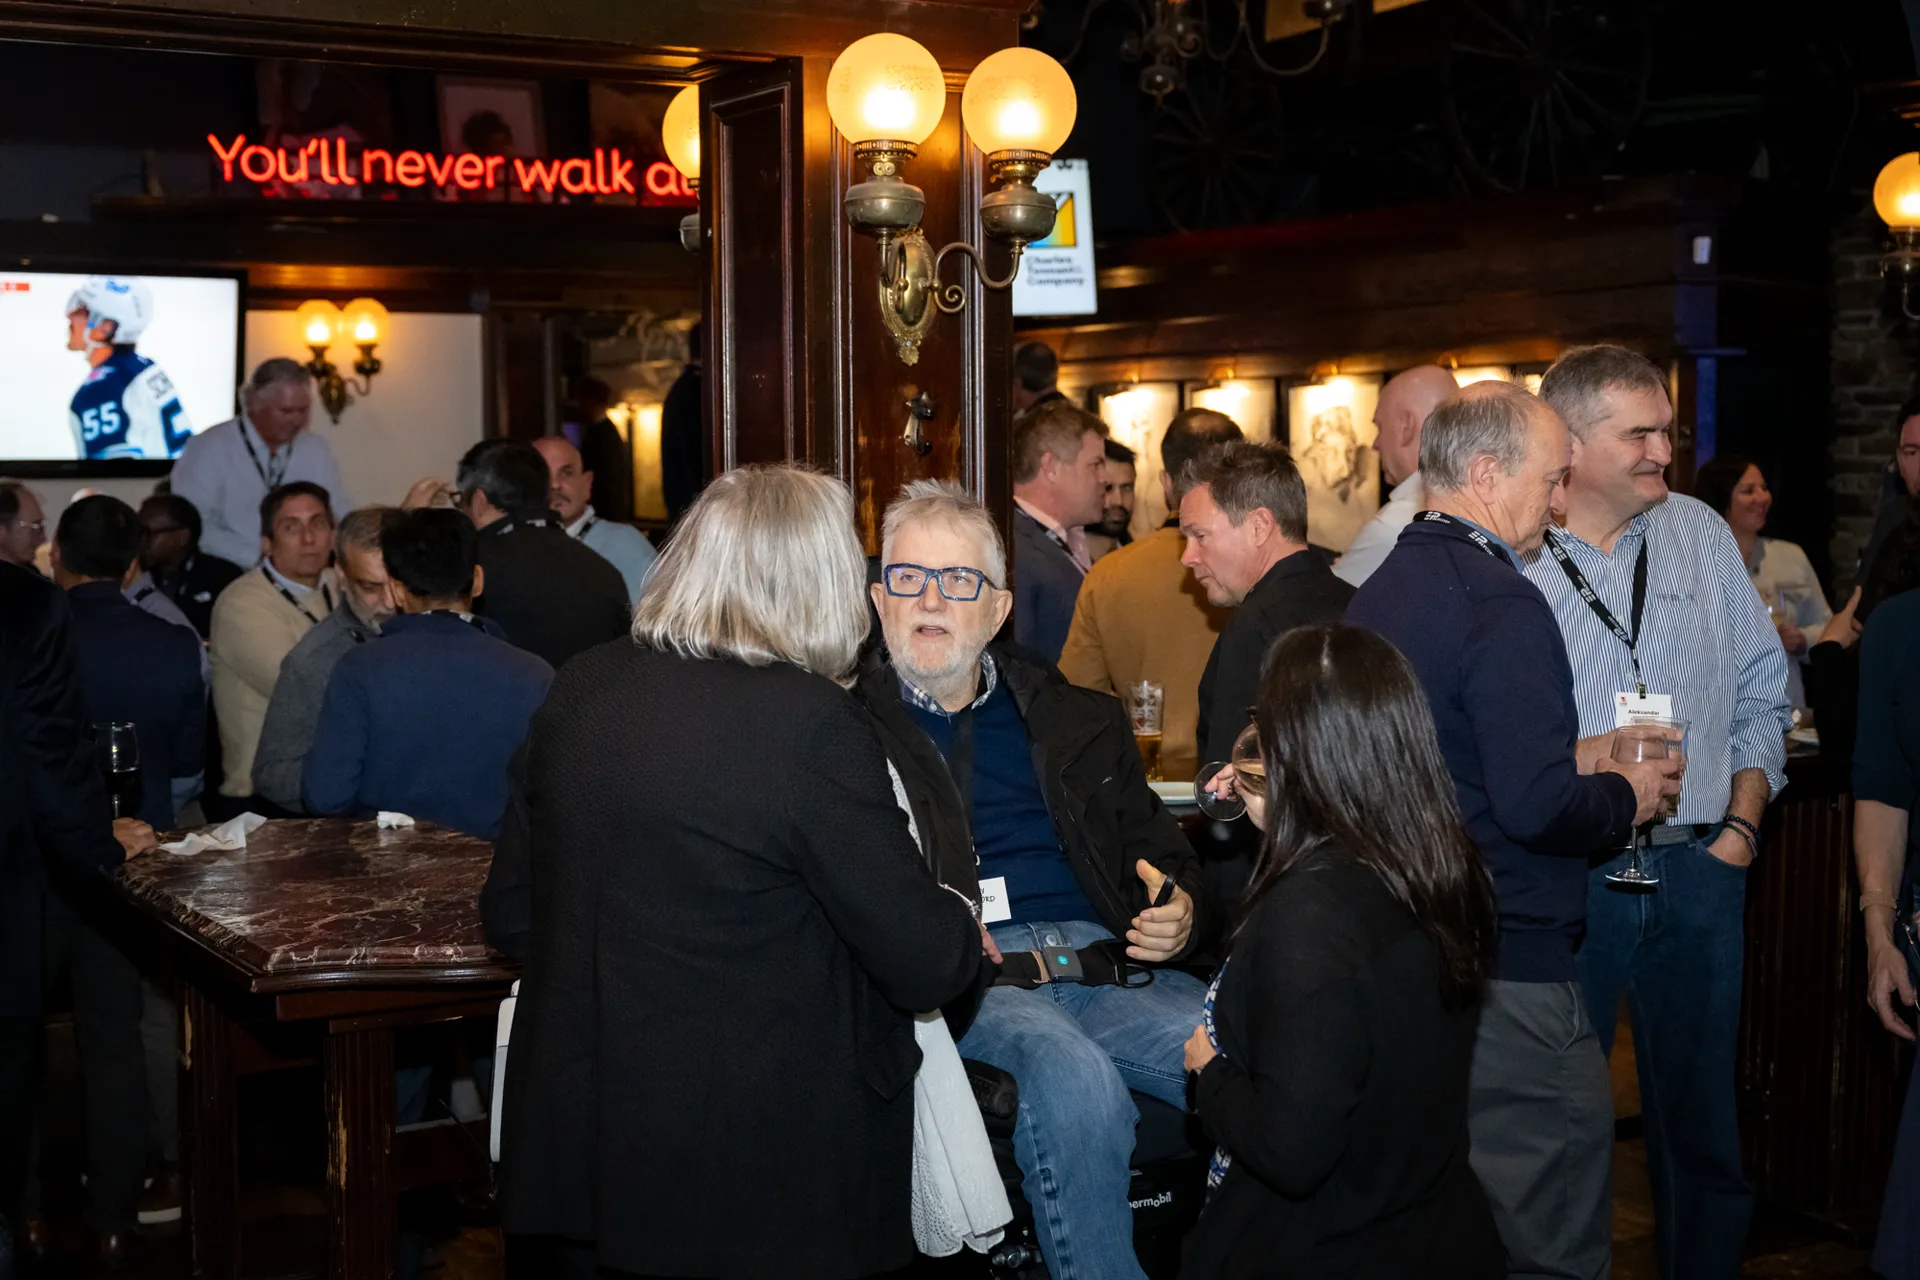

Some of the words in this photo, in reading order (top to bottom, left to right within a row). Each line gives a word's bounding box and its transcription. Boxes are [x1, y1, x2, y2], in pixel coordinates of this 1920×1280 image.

[207, 133, 358, 185] You'll
[362, 149, 505, 189] never
[513, 147, 636, 195] walk
[82, 400, 121, 441] 55
